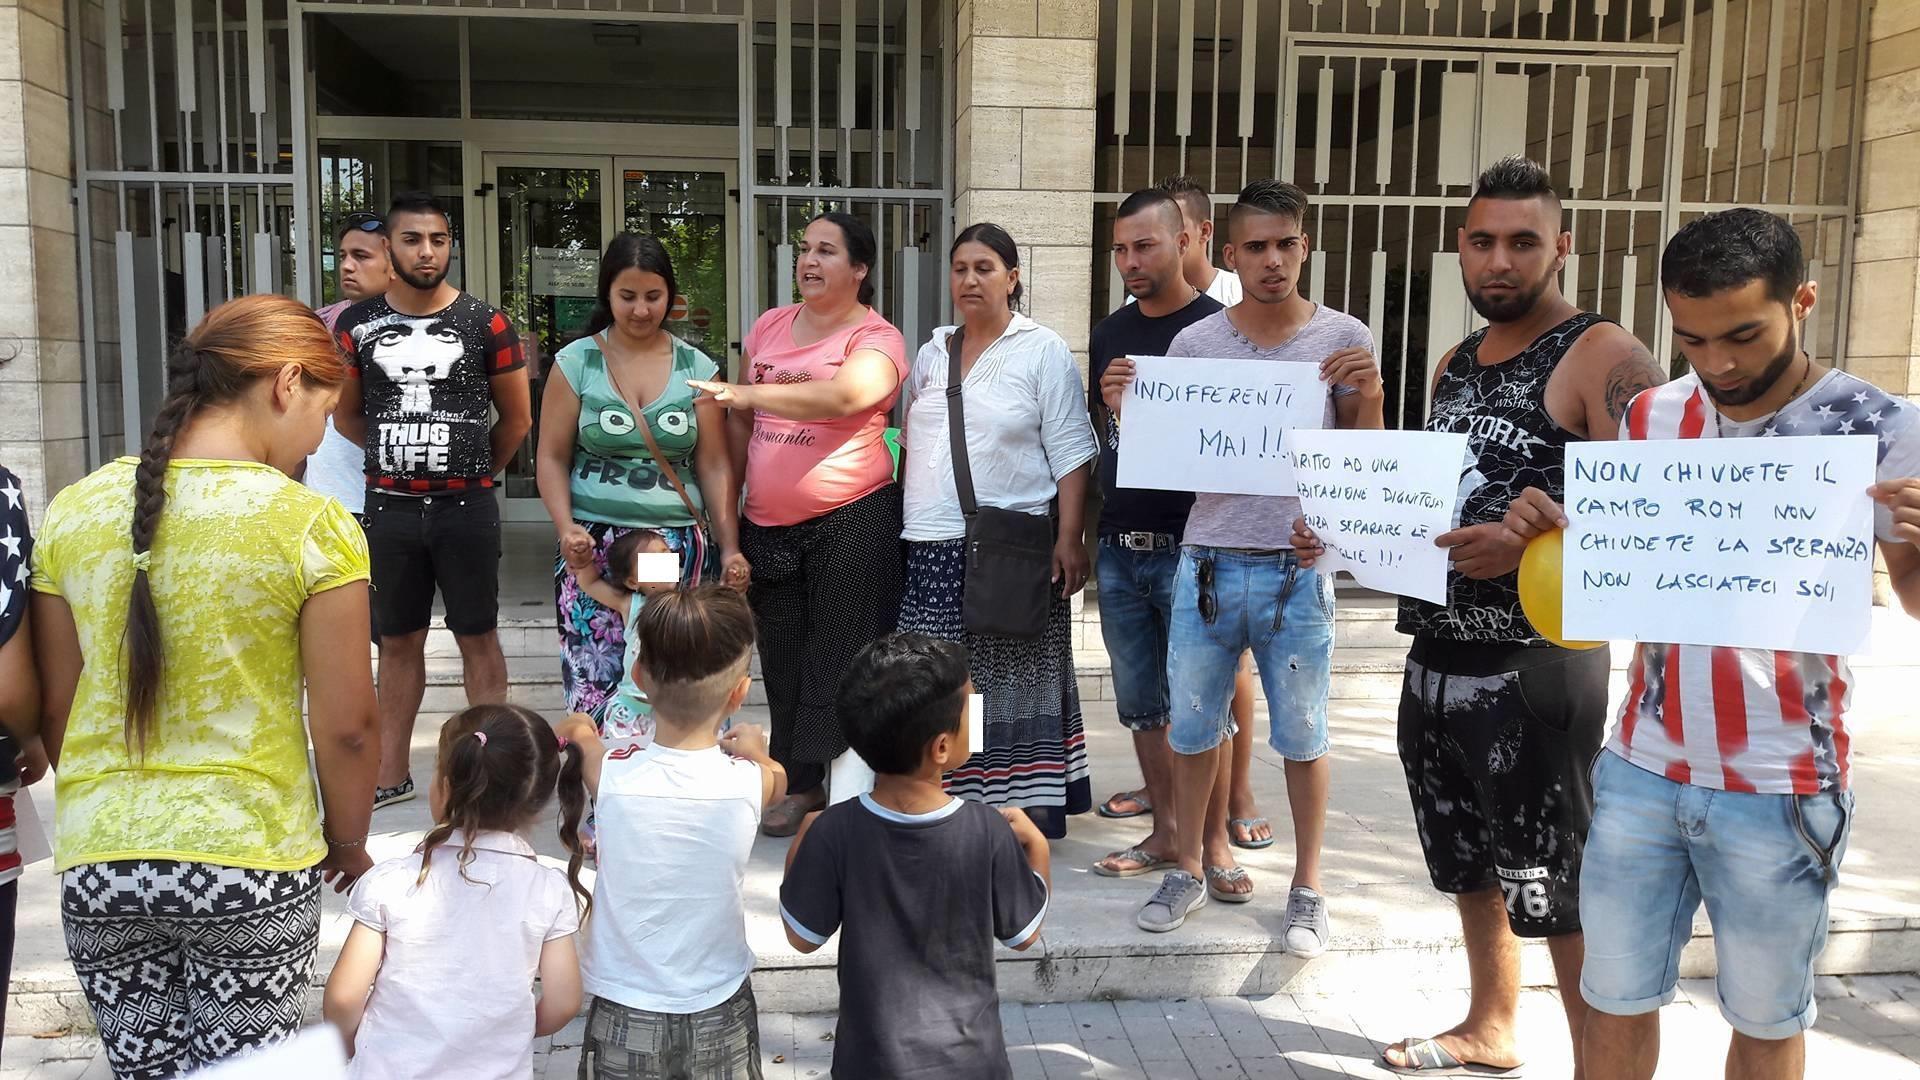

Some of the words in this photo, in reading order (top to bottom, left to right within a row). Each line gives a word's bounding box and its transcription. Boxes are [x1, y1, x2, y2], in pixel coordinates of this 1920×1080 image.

[1135, 378, 1296, 408] INDIFFERENTI
[1495, 399, 1538, 411] WISHES
[378, 423, 451, 446] THUG
[1199, 428, 1246, 458] MAI
[1467, 415, 1546, 459] YORK
[378, 446, 449, 472] LIFE
[1343, 457, 1362, 472] AD
[1371, 458, 1399, 473] UNA
[1575, 457, 1641, 484] NON
[1815, 460, 1837, 484] IL
[1382, 487, 1444, 509] DIGNITOSA
[1576, 497, 1660, 519] CAMPO
[1685, 498, 1743, 520] ROM
[1774, 503, 1817, 521] NON
[1304, 513, 1329, 530] ENZA
[1339, 519, 1402, 537] SEPARARE
[1717, 537, 1749, 553] LA
[1767, 536, 1868, 562] SPERANZA
[1583, 570, 1631, 591] NON
[1656, 572, 1777, 595] LASCIATECI
[1438, 601, 1521, 632] HAPPY
[1500, 869, 1536, 879] BRKLYN
[1500, 879, 1550, 918] 76
